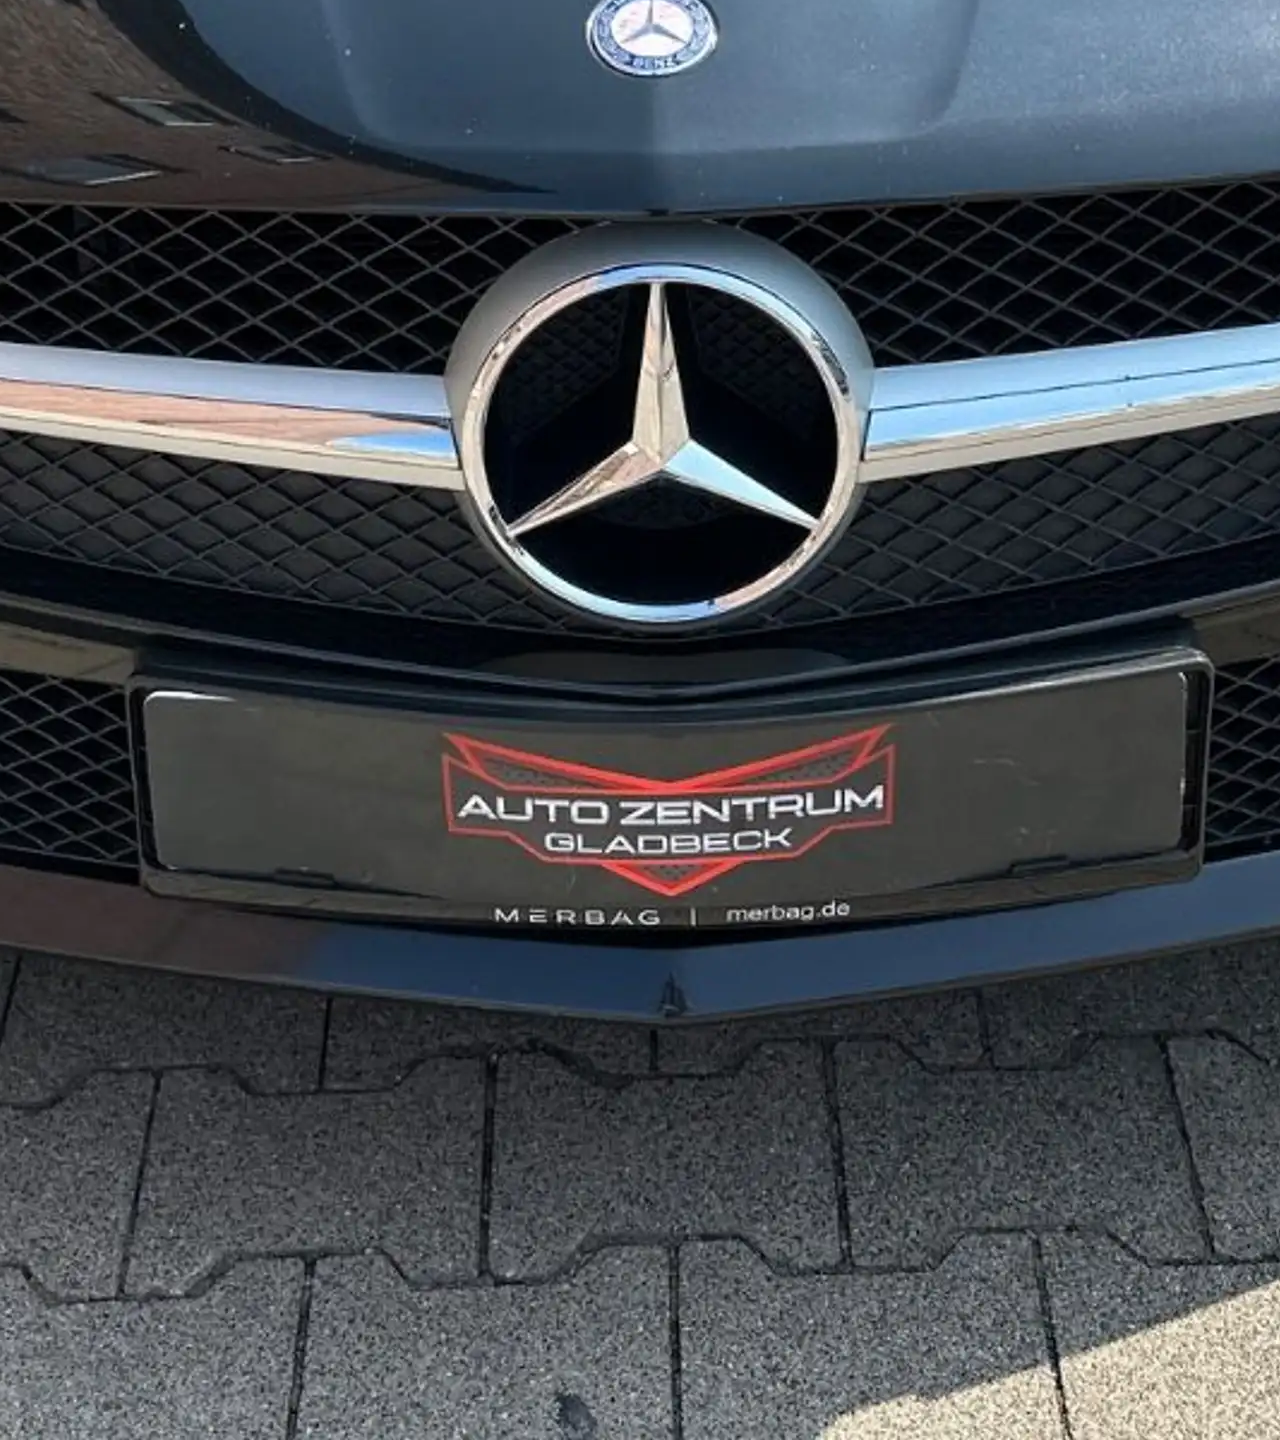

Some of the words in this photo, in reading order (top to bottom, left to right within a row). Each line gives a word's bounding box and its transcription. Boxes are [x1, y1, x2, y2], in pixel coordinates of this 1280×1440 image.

[457, 794, 610, 824] AUTO
[620, 785, 884, 825] ZENTRUM
[544, 827, 793, 854] GLADBECK
[494, 908, 661, 925] MERBAG
[726, 900, 850, 922] merbag.de
